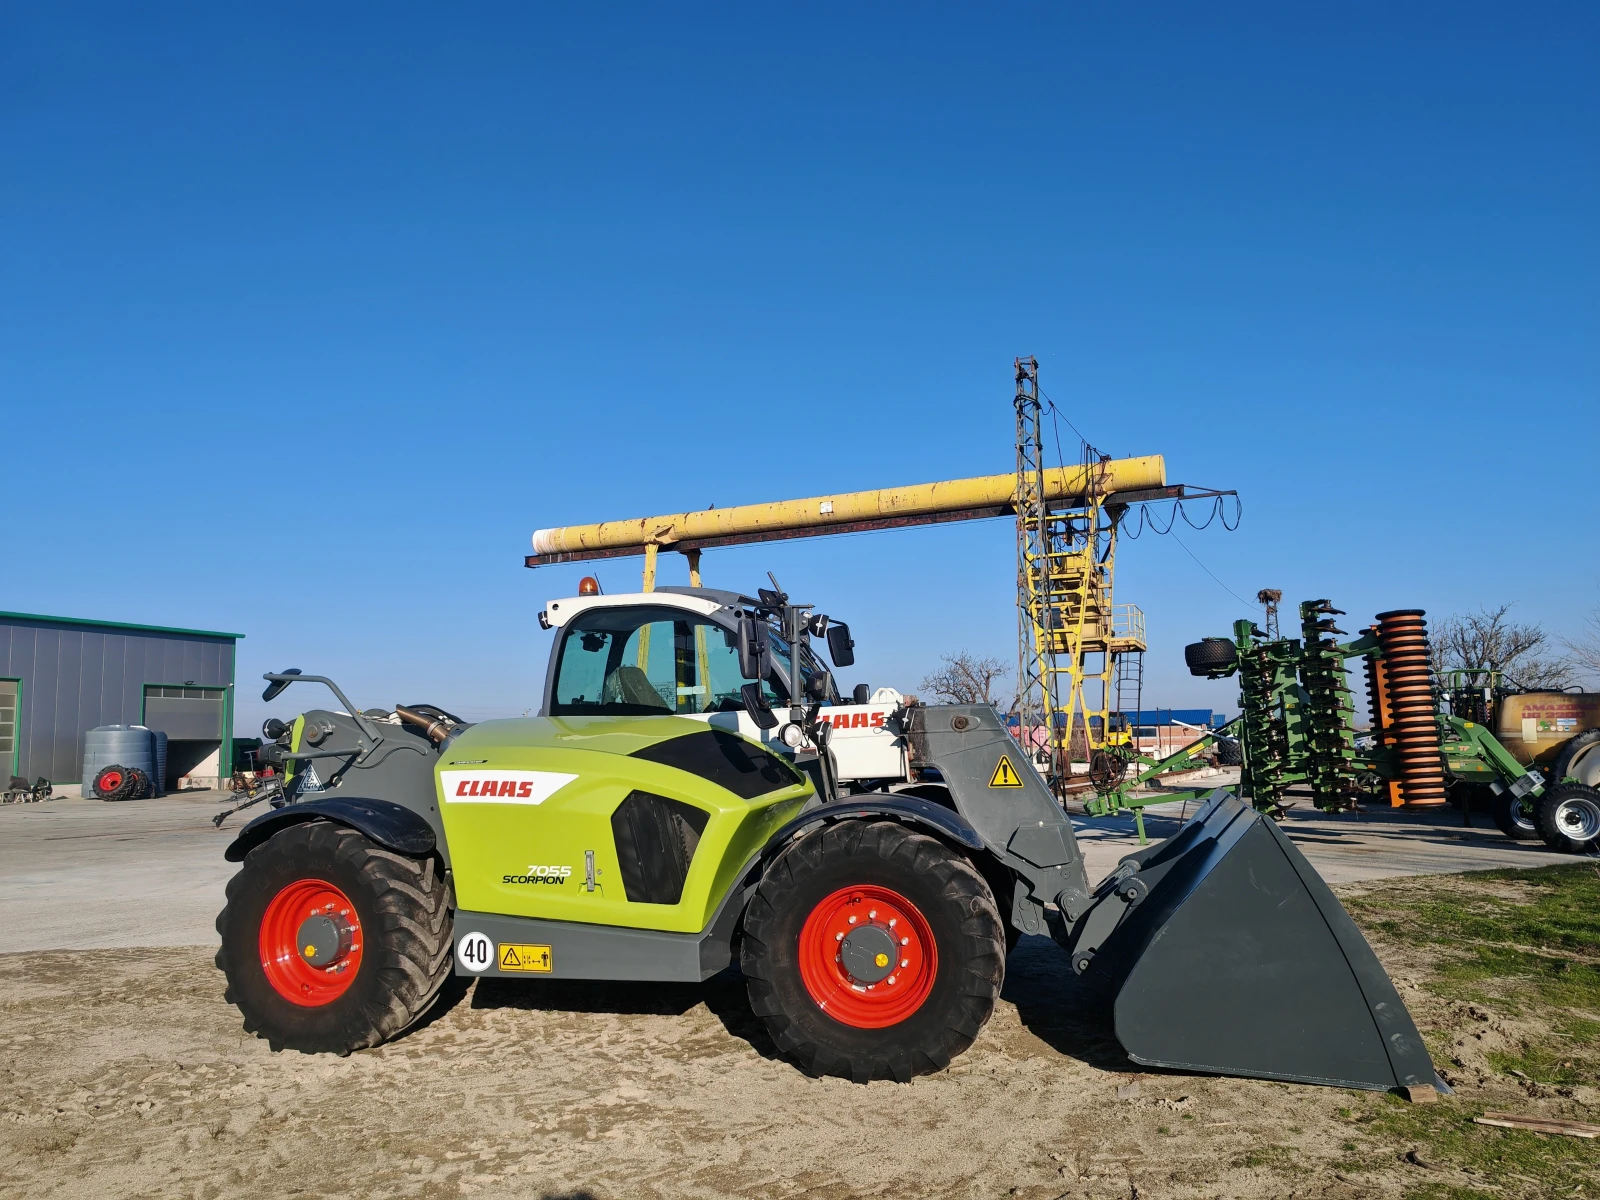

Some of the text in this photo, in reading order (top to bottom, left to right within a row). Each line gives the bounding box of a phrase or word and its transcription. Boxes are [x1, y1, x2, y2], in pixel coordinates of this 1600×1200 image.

[456, 780, 534, 798] CLAAS
[527, 864, 572, 877] 7055
[502, 875, 565, 885] SCORPION
[464, 938, 487, 964] 40
